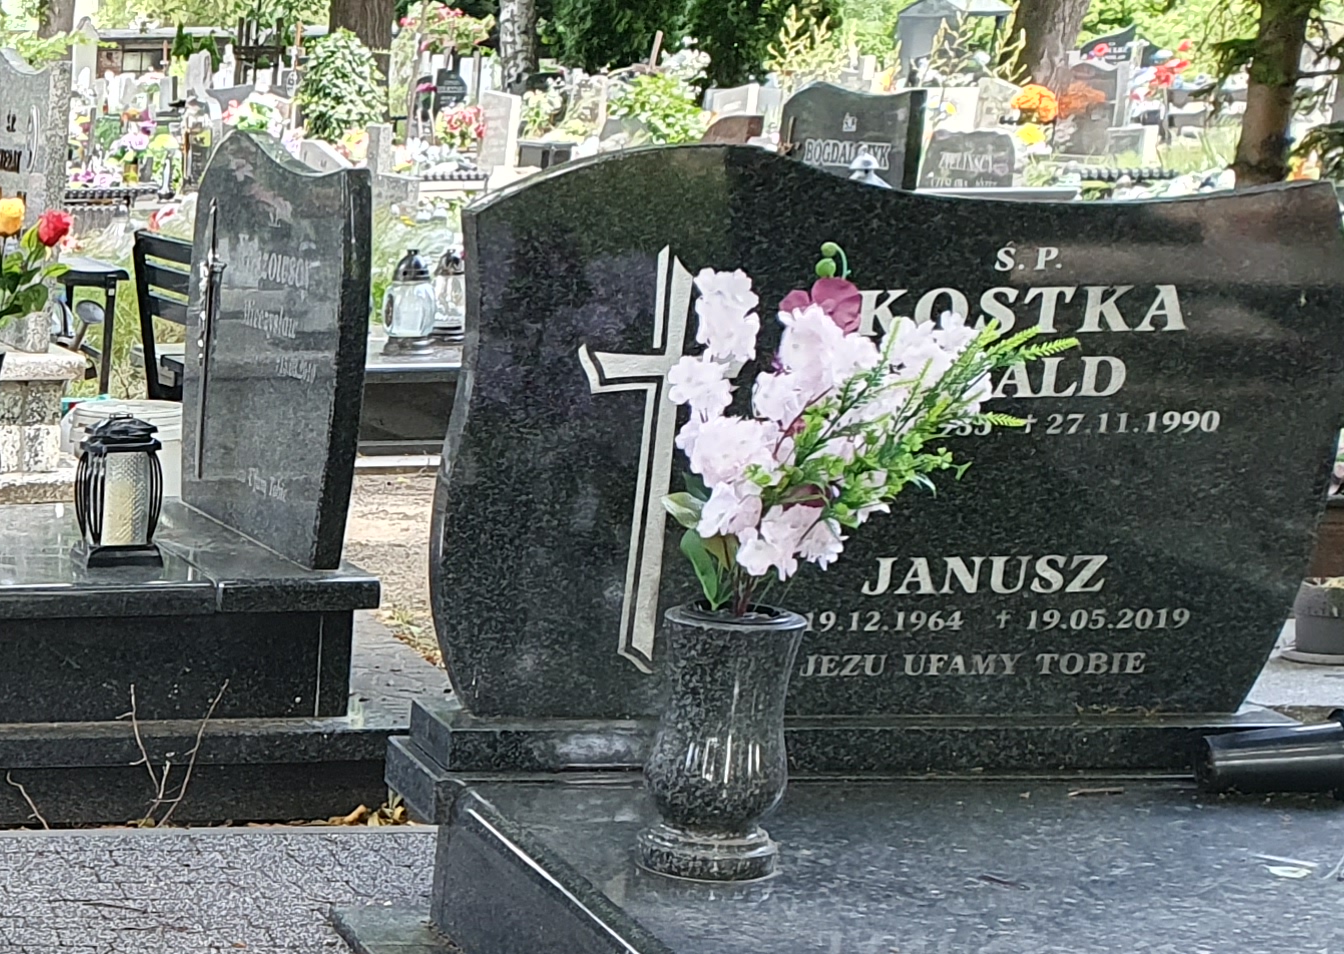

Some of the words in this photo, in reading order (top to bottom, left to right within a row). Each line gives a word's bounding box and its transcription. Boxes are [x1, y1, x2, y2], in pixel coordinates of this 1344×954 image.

[805, 139, 891, 170] BOGDALYK
[1035, 246, 1063, 271] P.
[858, 284, 1186, 338] KOSTKA
[1046, 410, 1221, 435] 27.11.1990
[861, 554, 1108, 596] JANUSZ
[803, 610, 964, 632] 19.12.1964
[1026, 607, 1190, 630] 19.05.2019
[800, 654, 888, 678] JEZU
[903, 653, 1021, 676] UFAMY
[1035, 651, 1146, 675] TOBIE
